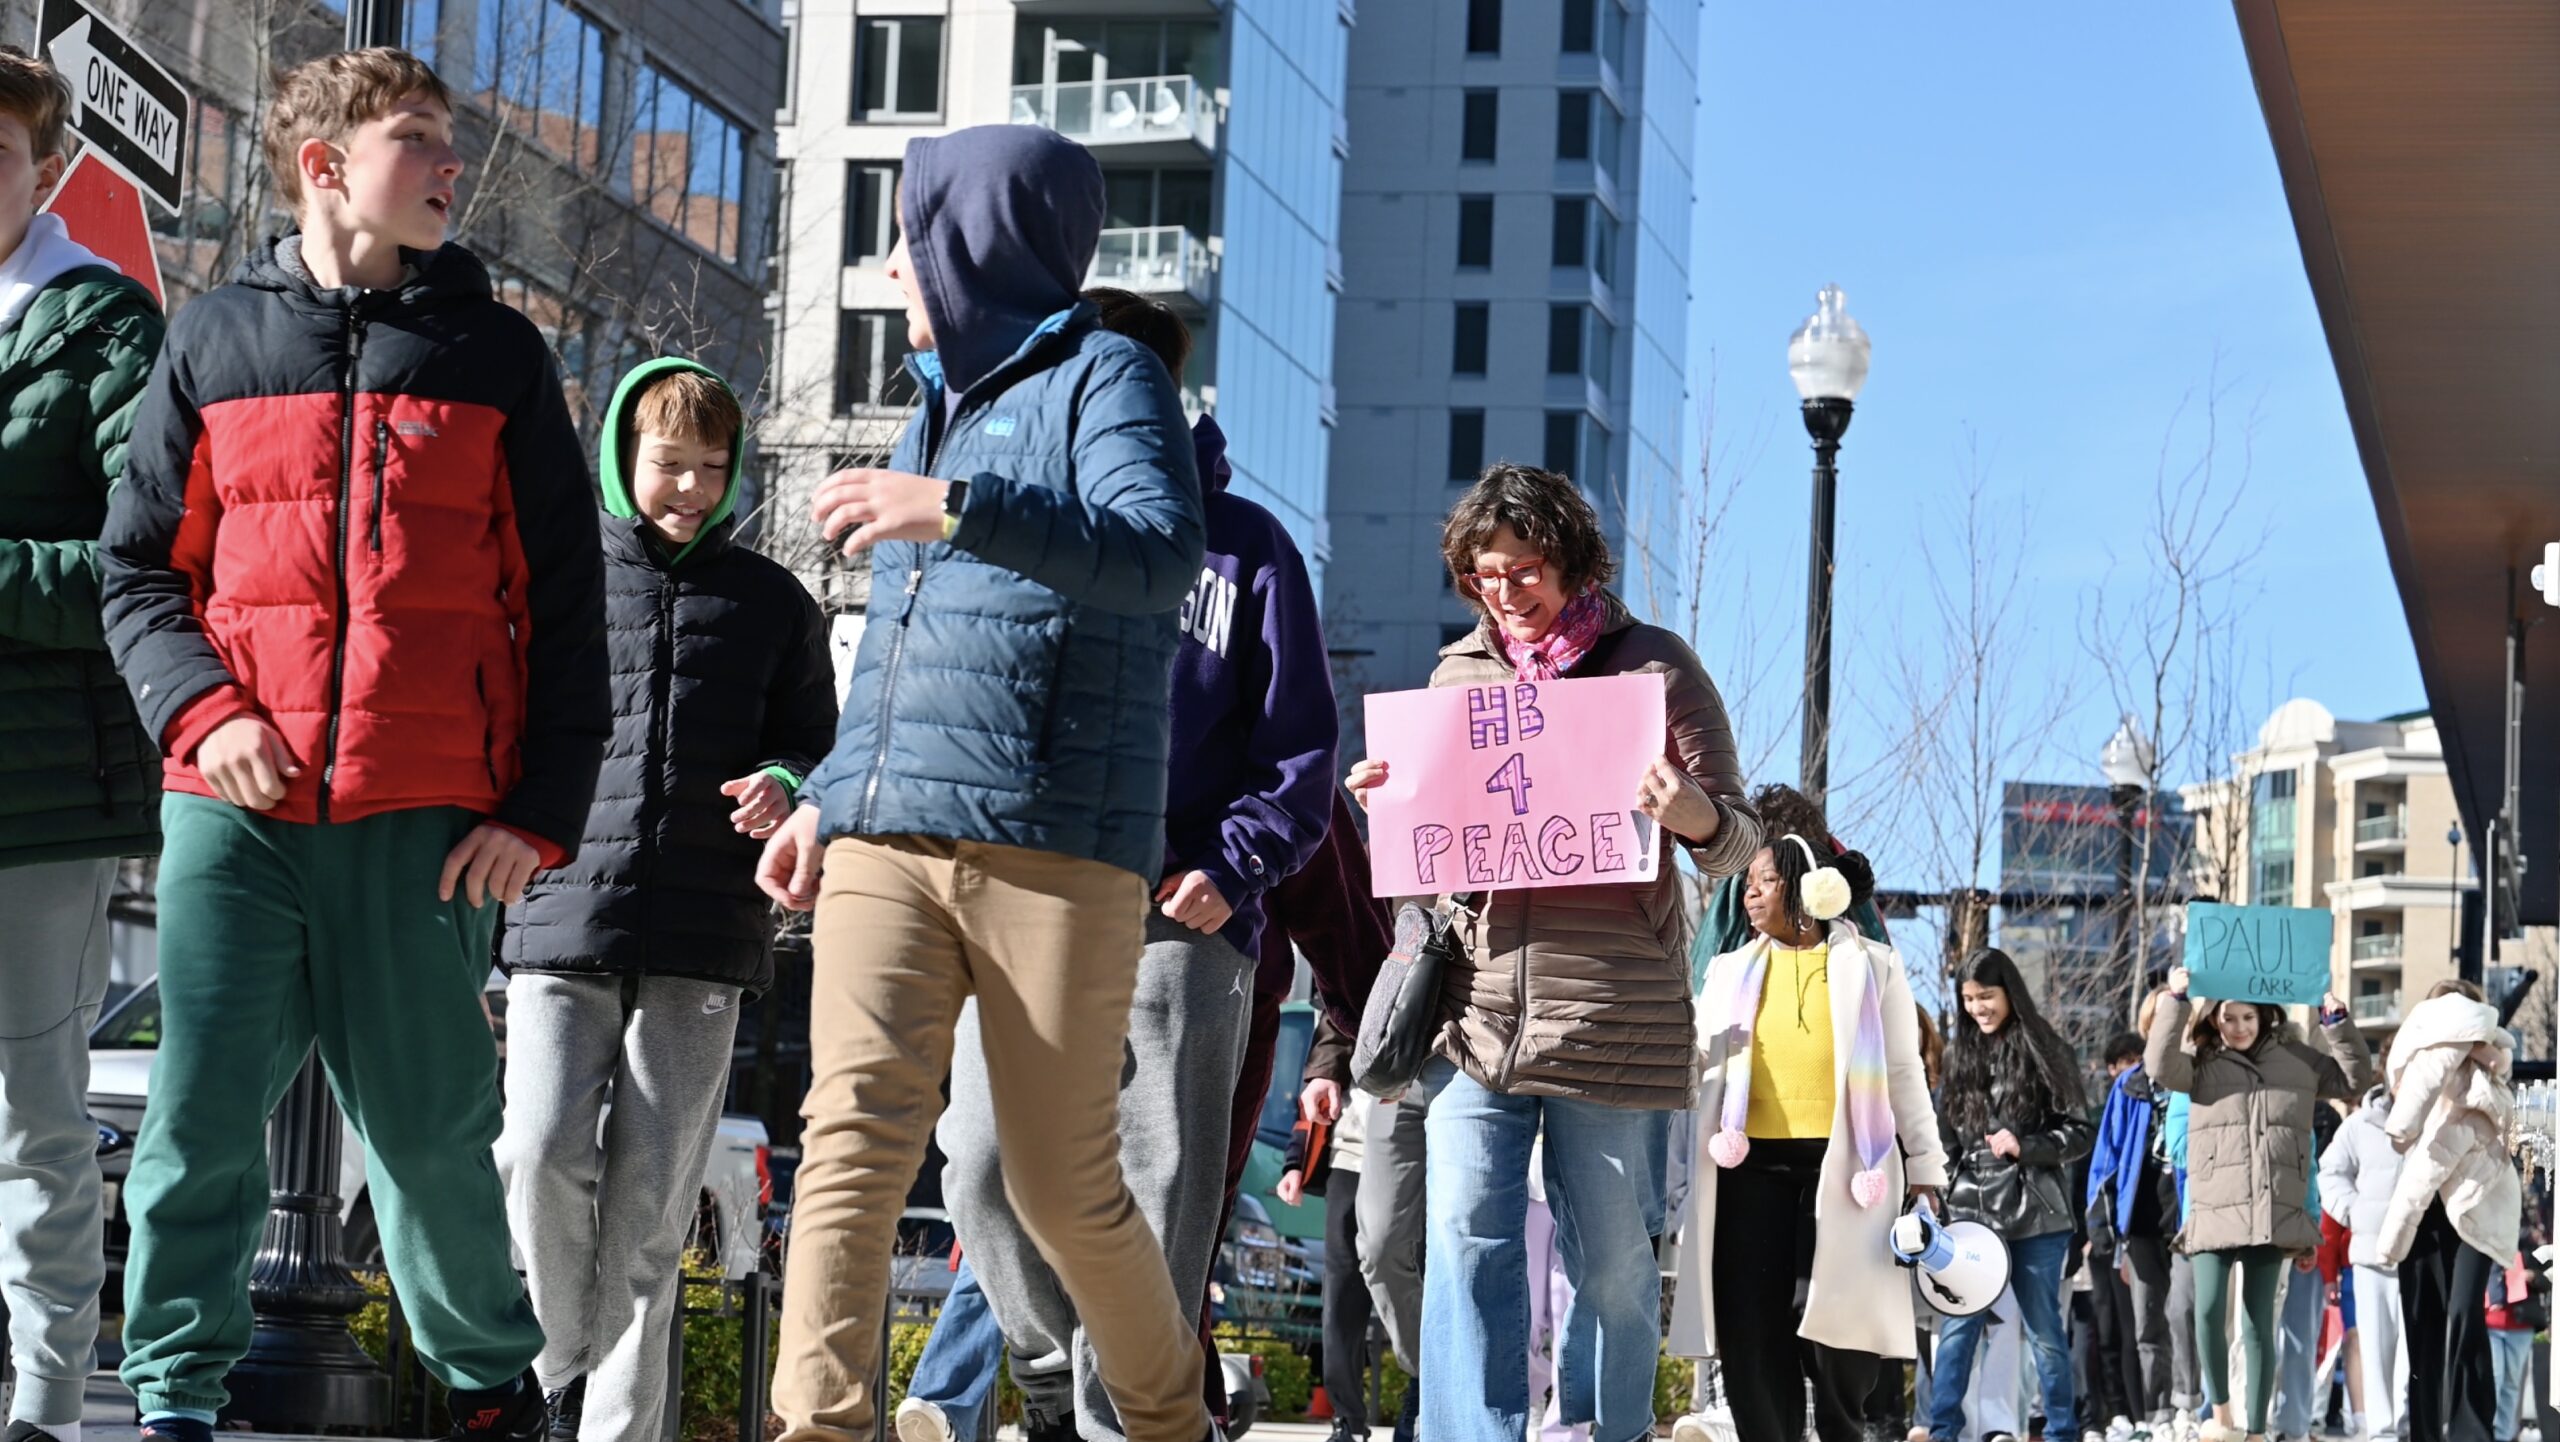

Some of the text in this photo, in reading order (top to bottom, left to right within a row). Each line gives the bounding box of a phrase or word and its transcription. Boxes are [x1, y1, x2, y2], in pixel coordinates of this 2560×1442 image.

[86, 55, 173, 161] ONE WAY
[1467, 682, 1545, 750] HB
[1486, 752, 1533, 816] 4
[1412, 809, 1654, 885] PEACE!
[2199, 915, 2308, 976] PAUL
[2248, 976, 2296, 998] CARR
